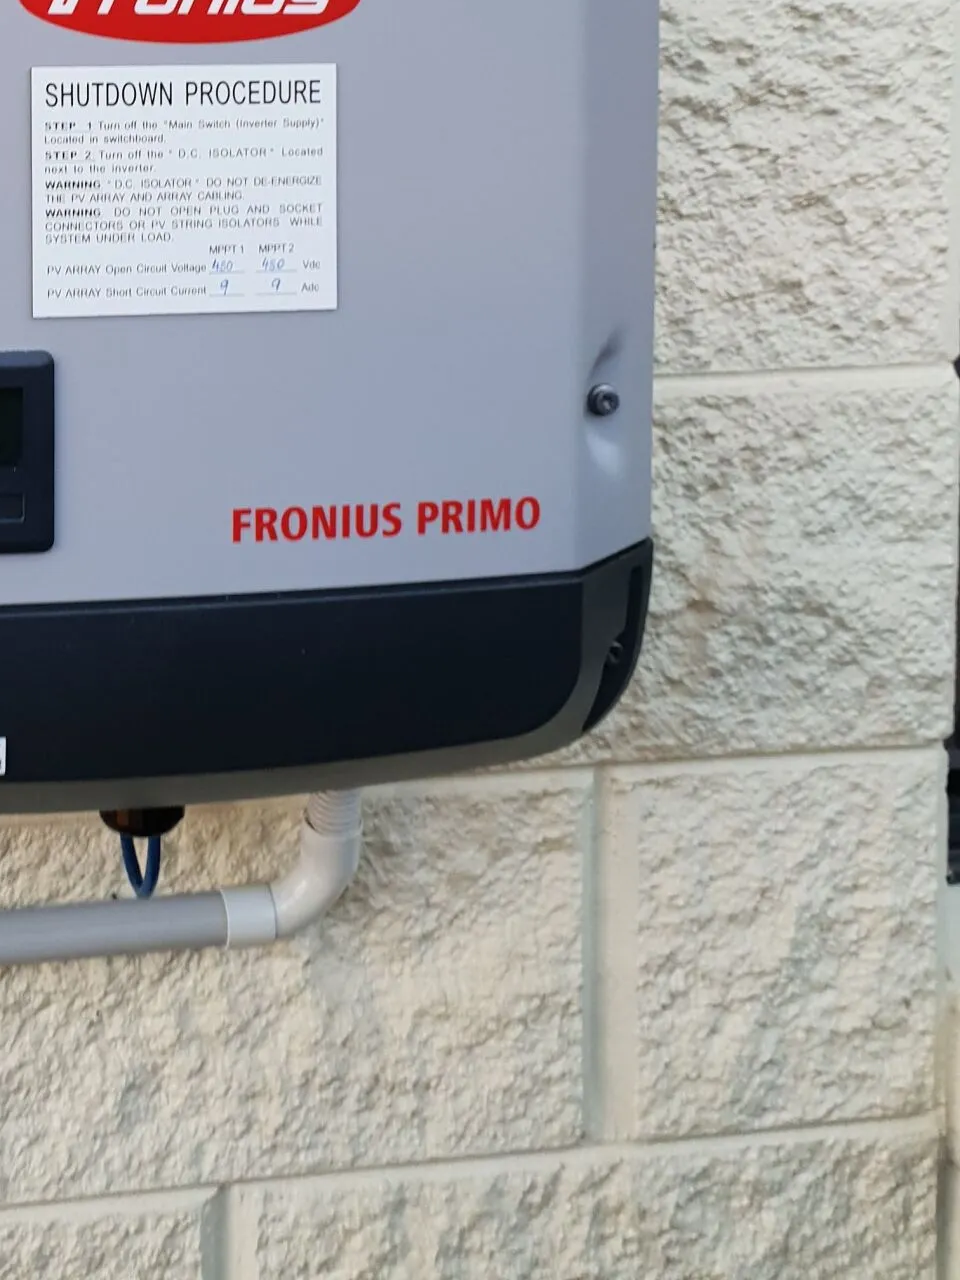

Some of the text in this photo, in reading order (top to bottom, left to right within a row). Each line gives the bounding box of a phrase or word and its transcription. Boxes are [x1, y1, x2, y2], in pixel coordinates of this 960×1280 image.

[45, 79, 322, 107] SHUTDOWN PROCEDURE
[44, 121, 76, 131] STEP
[99, 121, 120, 130] Turn
[124, 120, 137, 130] off
[142, 120, 158, 130] the
[163, 120, 192, 130] "Main
[198, 118, 230, 129] Switch
[236, 118, 277, 130] (Inverter
[44, 132, 167, 145] Located in switchboard.
[44, 151, 77, 160] STEP
[99, 150, 123, 160] Turn
[128, 149, 141, 159] off
[147, 149, 164, 159] the
[178, 148, 201, 159] D.C.
[208, 147, 267, 159] ISOLATOR
[281, 146, 323, 157] Located
[44, 163, 156, 174] next to the inverter.
[45, 180, 101, 190] WARNING
[141, 178, 191, 188] ISOLATOR
[206, 177, 222, 188] DO
[227, 176, 248, 187] NOT
[46, 190, 245, 204] THE PV ARRAY AND ARRAY CABLING.
[45, 203, 323, 218] WARNING DO NOT OPEN PLUG AND SOCKET
[45, 216, 323, 232] CONNECTORS OR PV STRING ISOLATORS WHILE
[45, 231, 174, 245] SYSTEM UNDER LOAD.
[209, 243, 236, 254] MPPT
[258, 242, 285, 254] MPPT
[288, 242, 295, 253] 2
[46, 261, 207, 276] PV ARRAY Open Circuit Voltage
[302, 258, 321, 270] Vdc
[47, 284, 207, 299] PV ARRAY Short Circuit Current
[220, 278, 229, 296] 9
[271, 277, 281, 293] 9
[301, 282, 320, 293] Adc
[232, 496, 541, 543] FRONIUS PRIMO
